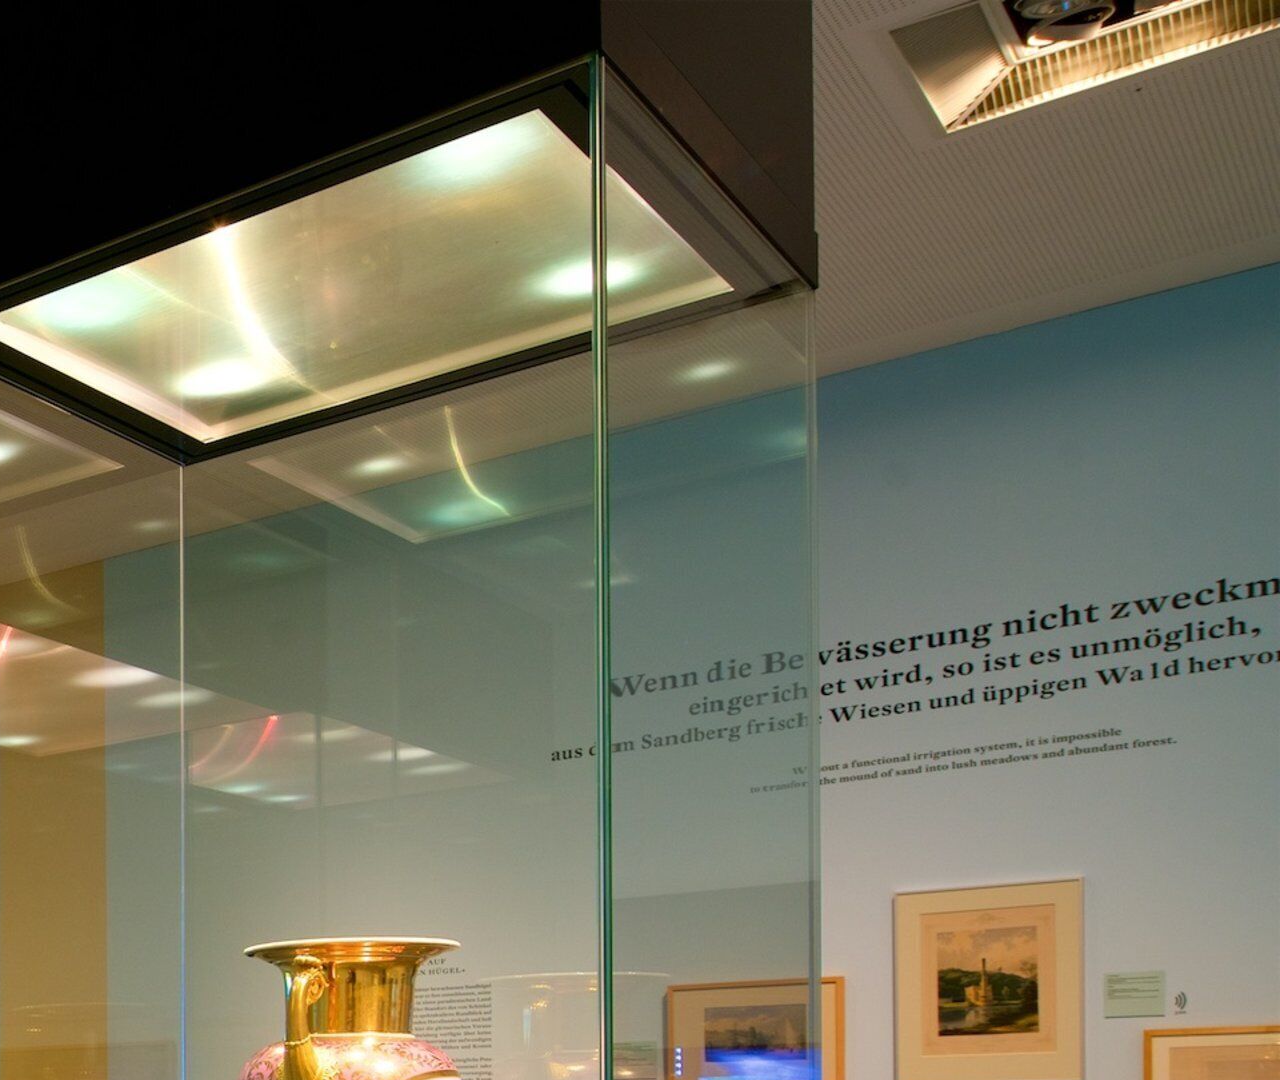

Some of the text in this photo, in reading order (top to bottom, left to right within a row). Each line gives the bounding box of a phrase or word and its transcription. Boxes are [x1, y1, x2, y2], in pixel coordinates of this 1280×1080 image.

[611, 670, 699, 698] Wenn
[707, 658, 752, 683] die
[1002, 603, 1100, 638] nicht
[689, 616, 1262, 716] eingerichet wird, so ist es unmöglich,
[551, 746, 583, 761] aus
[641, 724, 741, 750] Sandberg
[746, 713, 823, 737] frisch
[830, 698, 923, 723] Wiesen
[929, 689, 976, 710] und
[982, 675, 1088, 705] üppigen
[1096, 659, 1180, 686] Wald
[1188, 650, 1280, 674] hervo
[852, 753, 911, 768] functional
[913, 746, 974, 761] irrigation
[975, 740, 1023, 754] system,
[1026, 737, 1036, 747] it
[1038, 736, 1049, 746] is
[1052, 728, 1122, 745] impossible
[839, 770, 878, 783] mound
[881, 768, 893, 778] of
[896, 766, 922, 776] sand
[925, 763, 949, 773] into
[951, 757, 977, 769] lush
[980, 751, 1039, 767] meadows
[1042, 748, 1065, 759] and
[1068, 742, 1128, 757] abundant
[1133, 736, 1178, 749] forest.
